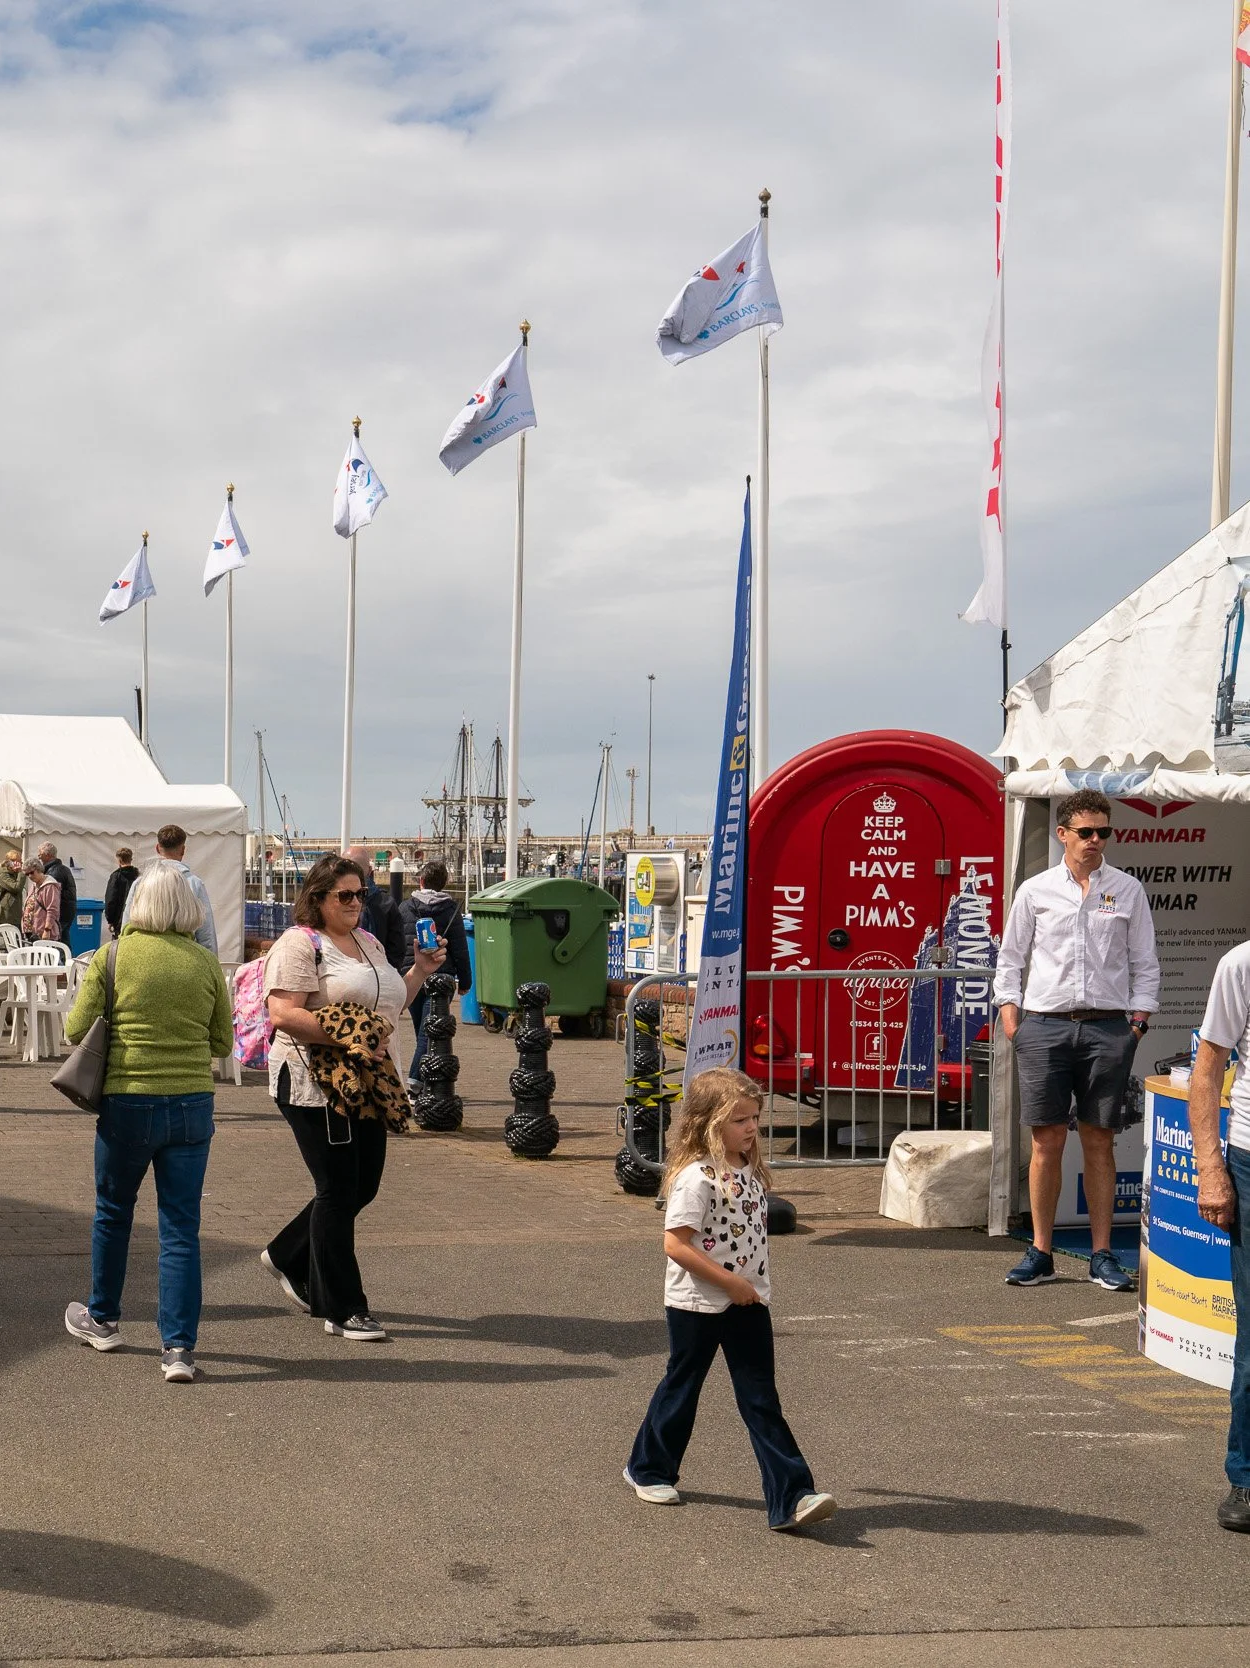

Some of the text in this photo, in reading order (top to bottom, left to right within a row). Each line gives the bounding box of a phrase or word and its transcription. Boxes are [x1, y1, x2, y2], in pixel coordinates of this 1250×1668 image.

[710, 303, 759, 333] BARCLAYS
[482, 415, 519, 440] BARCLAYS
[864, 816, 904, 828] KEEP
[714, 772, 744, 915] Marine
[861, 829, 906, 841] CALM
[1113, 828, 1207, 843] YANMAR
[867, 846, 898, 856] AND
[849, 861, 916, 879] HAVE
[1182, 866, 1233, 883] WITH
[871, 883, 890, 900] A
[1146, 893, 1199, 910] NMAR
[845, 900, 916, 929] PIMM'S
[954, 856, 994, 1016] LEMONADE
[1154, 927, 1247, 937] gically advanced YANMAR
[1183, 939, 1196, 947] life
[857, 955, 882, 967] EVENTS
[889, 1021, 904, 1029] 425
[1155, 1115, 1193, 1151] Marine
[1161, 1150, 1197, 1170] BOAT
[1157, 1164, 1199, 1187] &CHAN
[1115, 1178, 1143, 1196] rine
[1159, 1187, 1175, 1198] COMPLETE
[1152, 1215, 1158, 1226] St
[1157, 1217, 1182, 1236] Sampsons,
[1182, 1226, 1211, 1244] Guernsey
[1212, 1294, 1236, 1308] BRITISH
[1211, 1303, 1237, 1317] MARINE
[1155, 1329, 1174, 1344] YANMAR
[1179, 1336, 1212, 1353] VOLVO
[1179, 1344, 1212, 1361] PENTA
